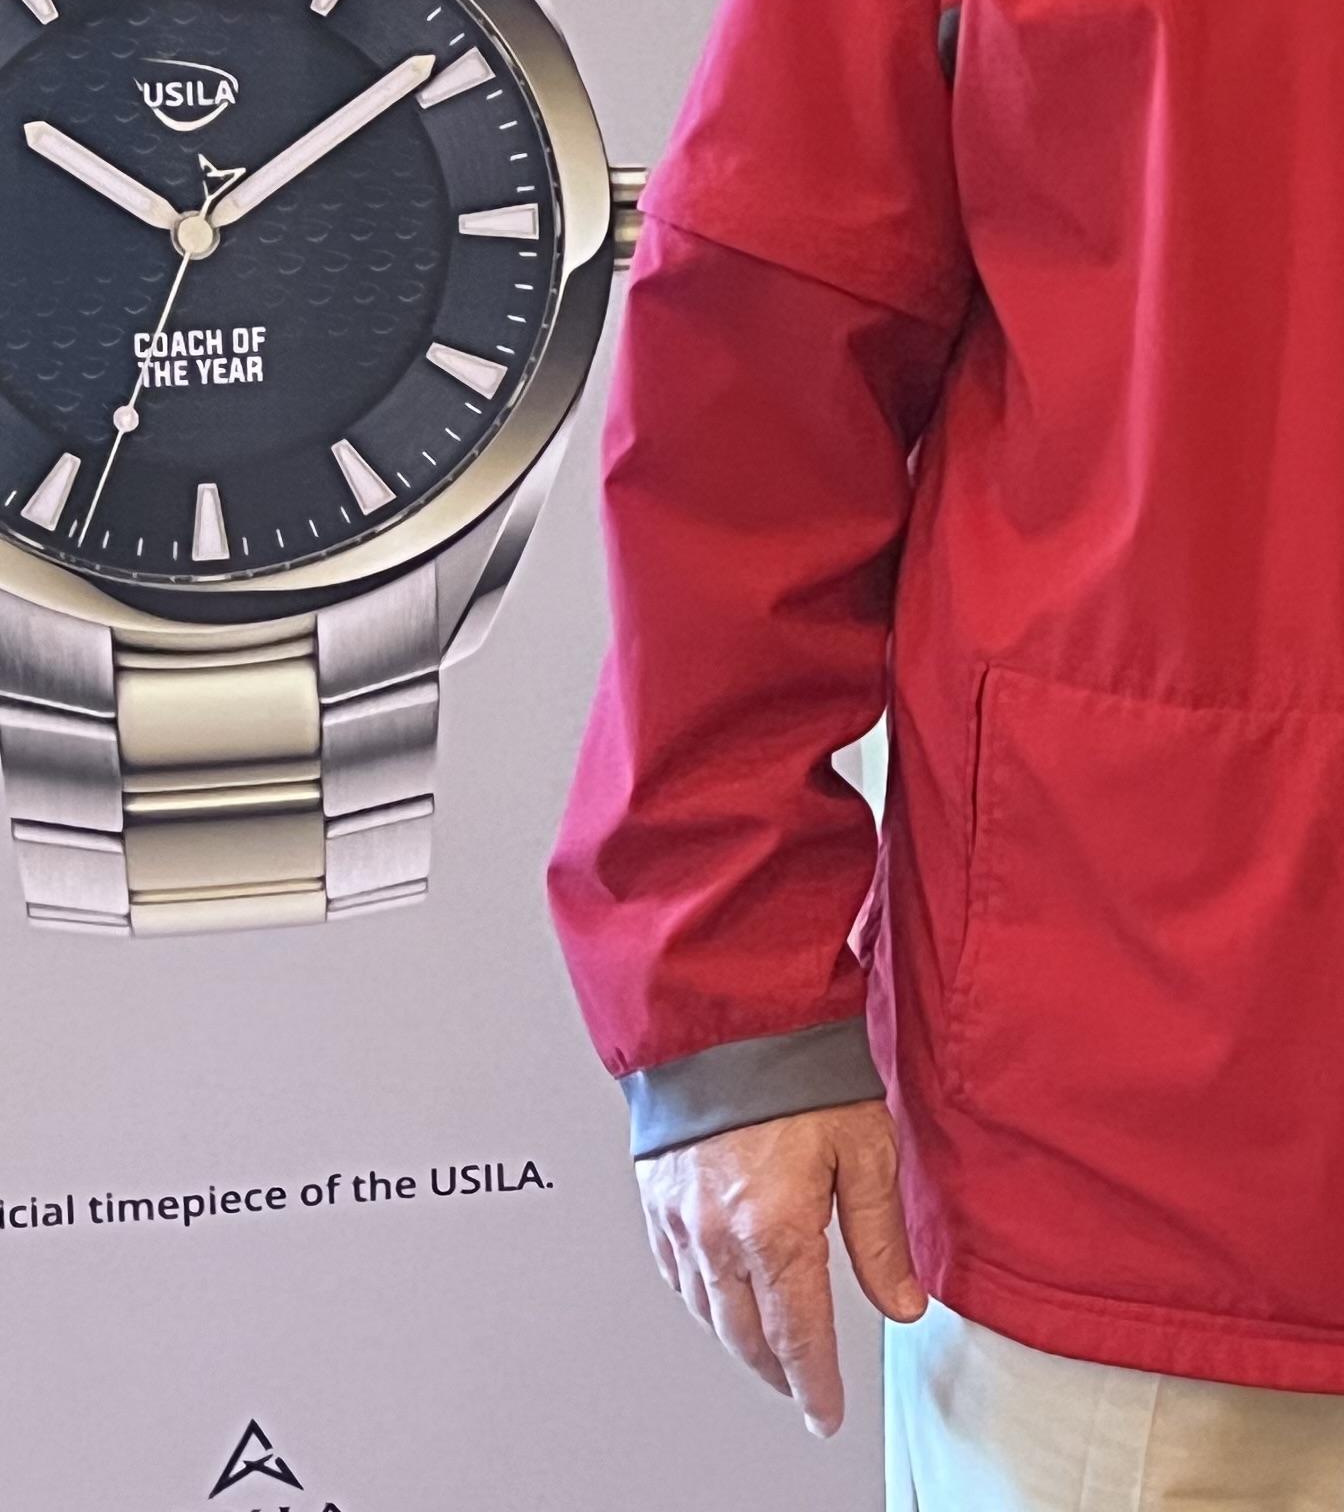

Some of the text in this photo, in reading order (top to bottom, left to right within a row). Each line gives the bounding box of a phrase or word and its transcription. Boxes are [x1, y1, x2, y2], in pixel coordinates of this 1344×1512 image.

[142, 79, 237, 109] USILA
[133, 326, 267, 359] COACH OF
[137, 355, 264, 388] THE YEAR
[88, 1185, 288, 1227] timepiece
[300, 1173, 344, 1207] of
[352, 1170, 418, 1203] the
[430, 1159, 556, 1197] USILA.
